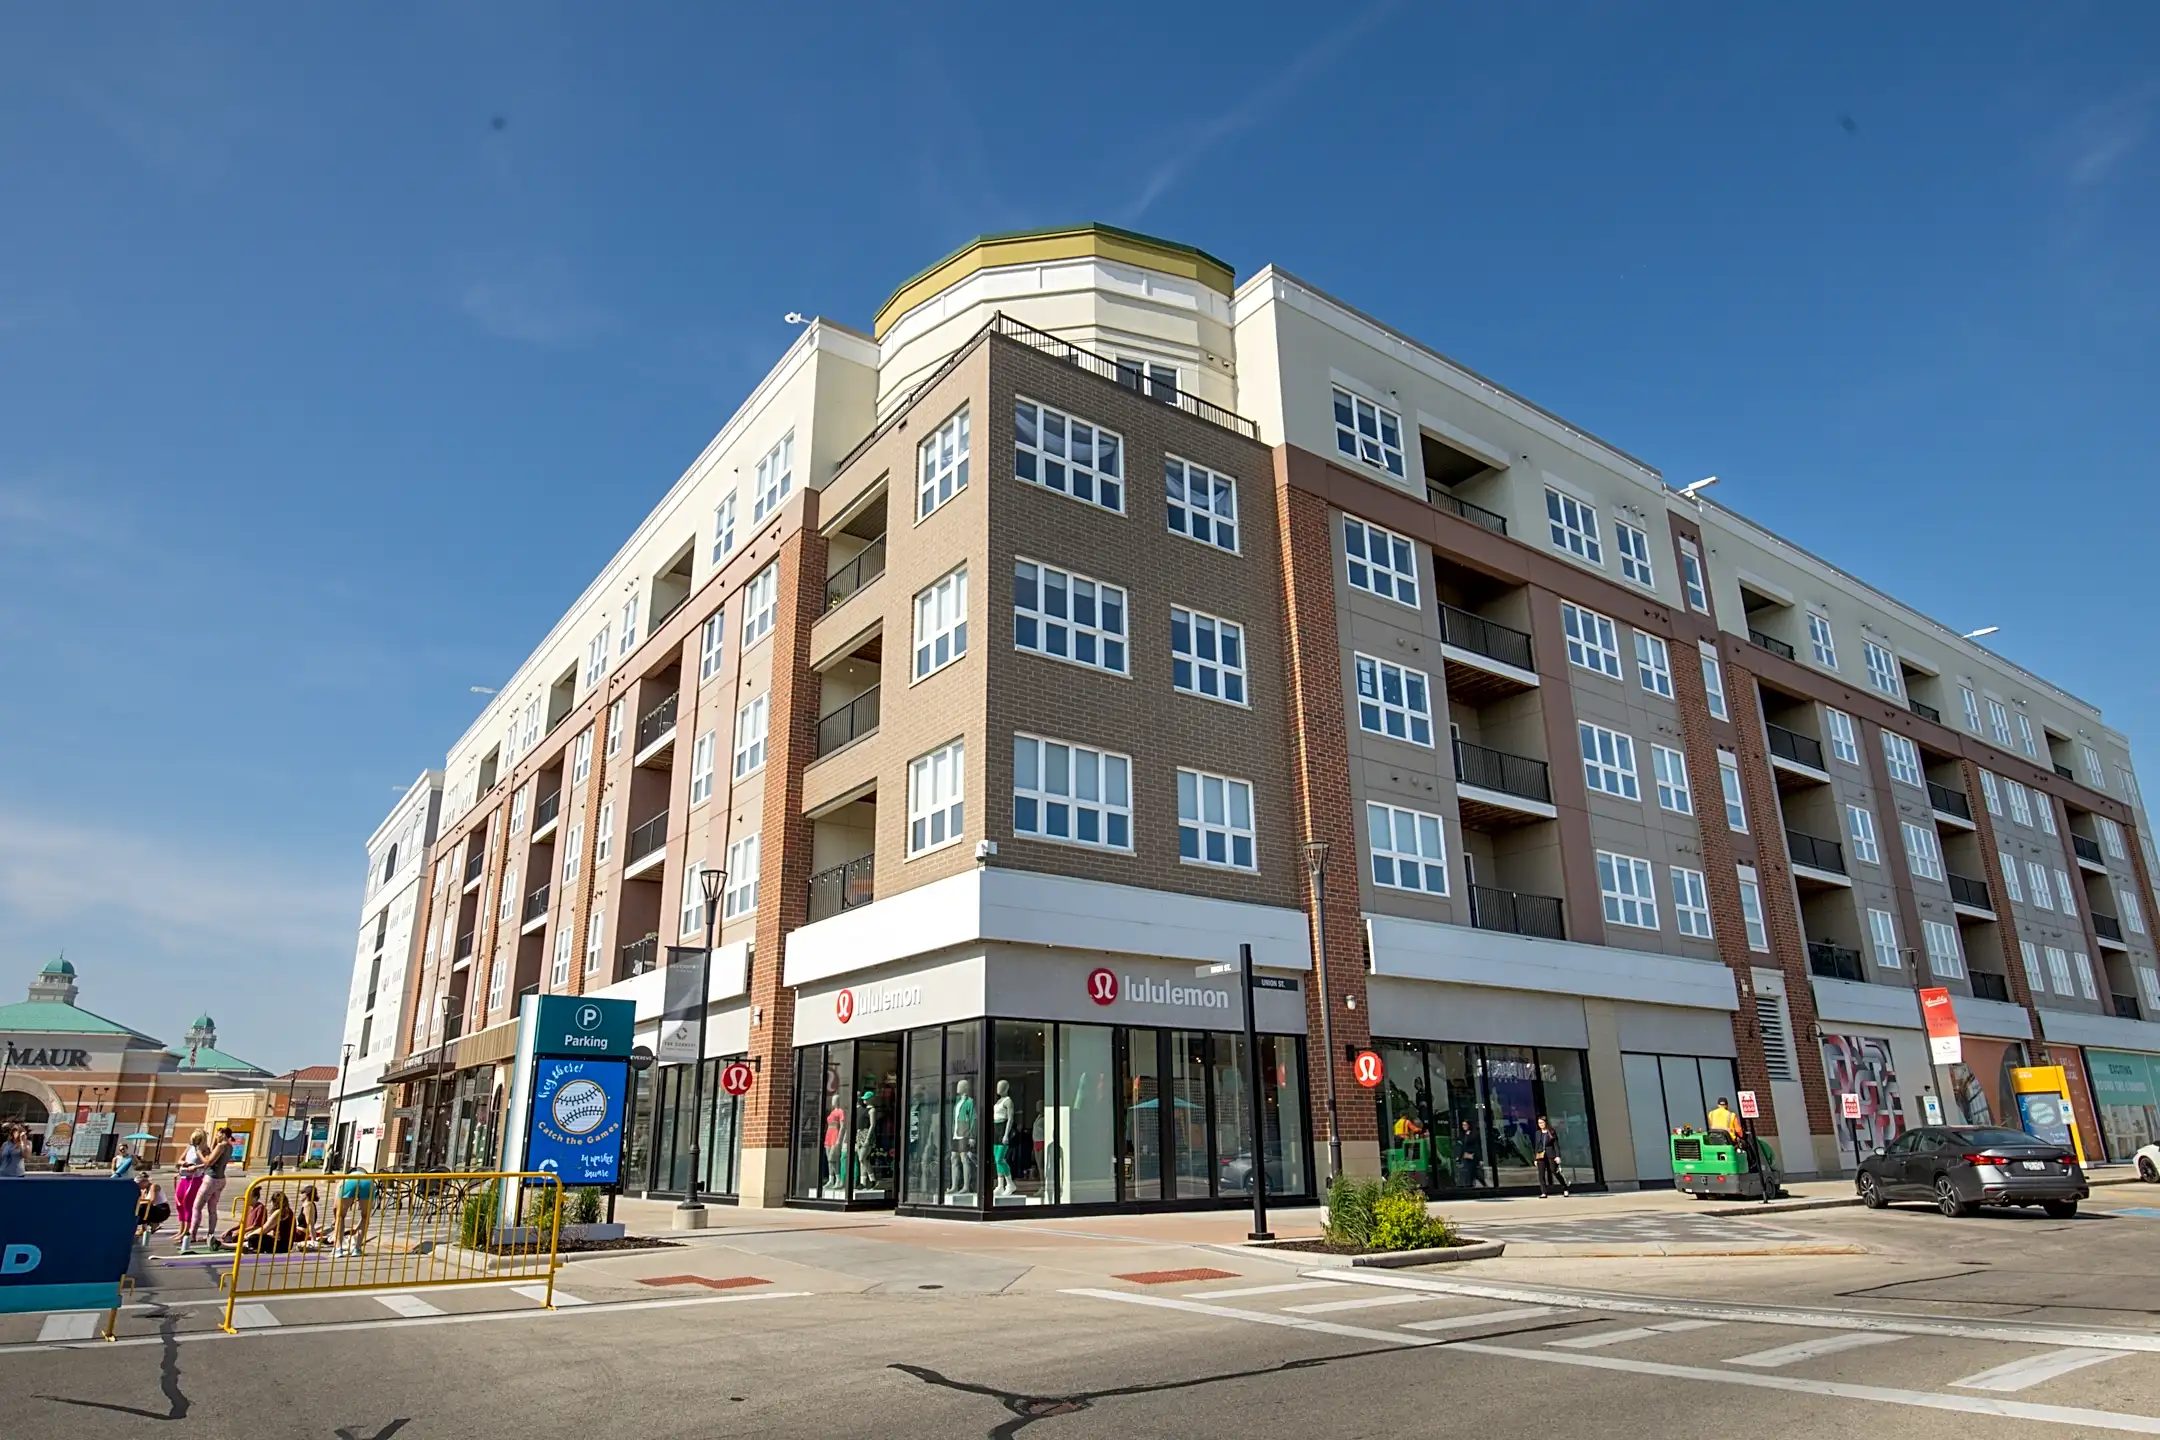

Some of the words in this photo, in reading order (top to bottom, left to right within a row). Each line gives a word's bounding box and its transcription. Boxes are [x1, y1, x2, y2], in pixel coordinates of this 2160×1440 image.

[1125, 975, 1228, 1009] lululemon
[1261, 979, 1278, 987] UNION
[1278, 980, 1286, 988] ST.
[856, 986, 922, 1016] lululemon
[583, 1009, 597, 1026] P
[564, 1034, 608, 1050] Parking
[6, 1048, 88, 1067] MAUR
[538, 1121, 563, 1142] Catch
[566, 1137, 583, 1145] the
[586, 1122, 619, 1144] Games
